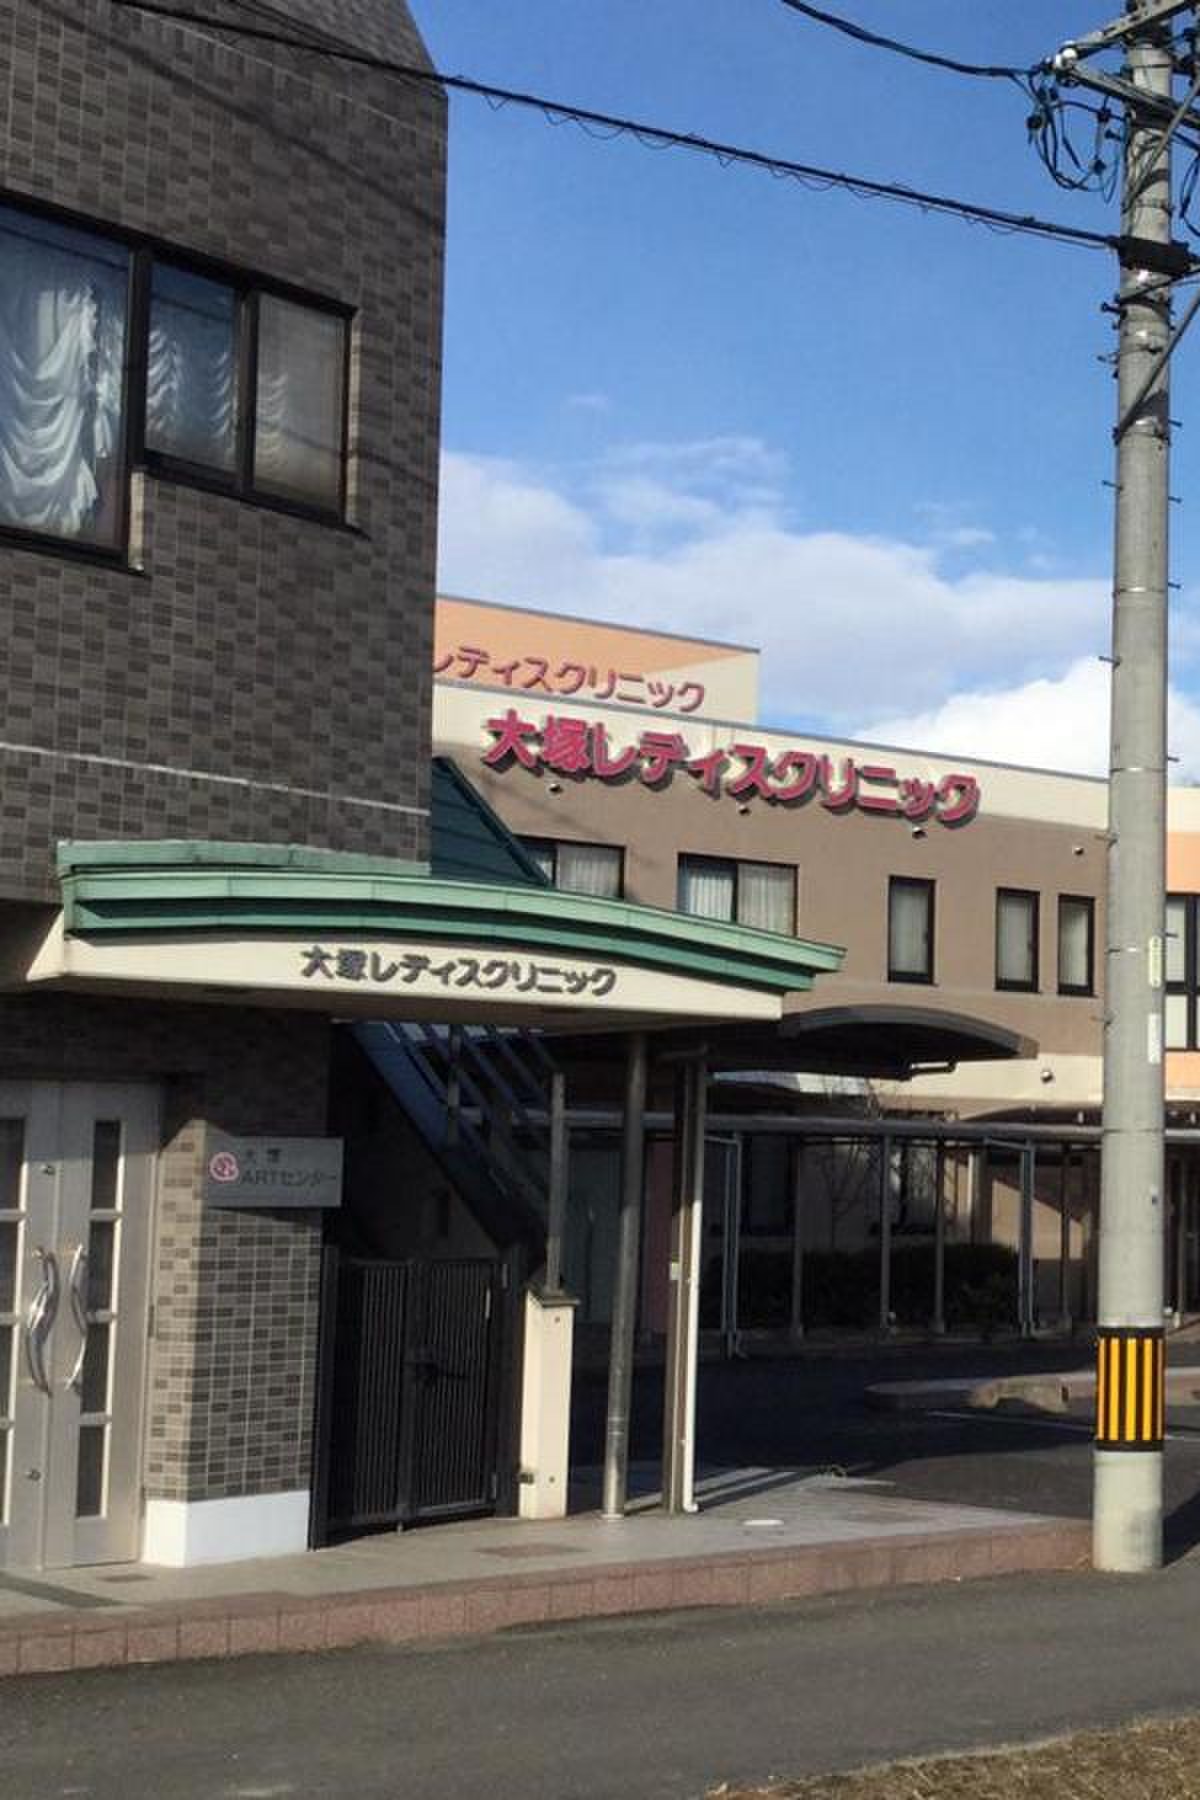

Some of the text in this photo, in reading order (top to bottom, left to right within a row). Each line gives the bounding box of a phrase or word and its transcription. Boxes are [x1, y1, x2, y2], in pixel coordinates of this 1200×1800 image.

[485, 709, 979, 822] 大塚レディスクリニック
[301, 945, 616, 996] 大塚レディスクリニック
